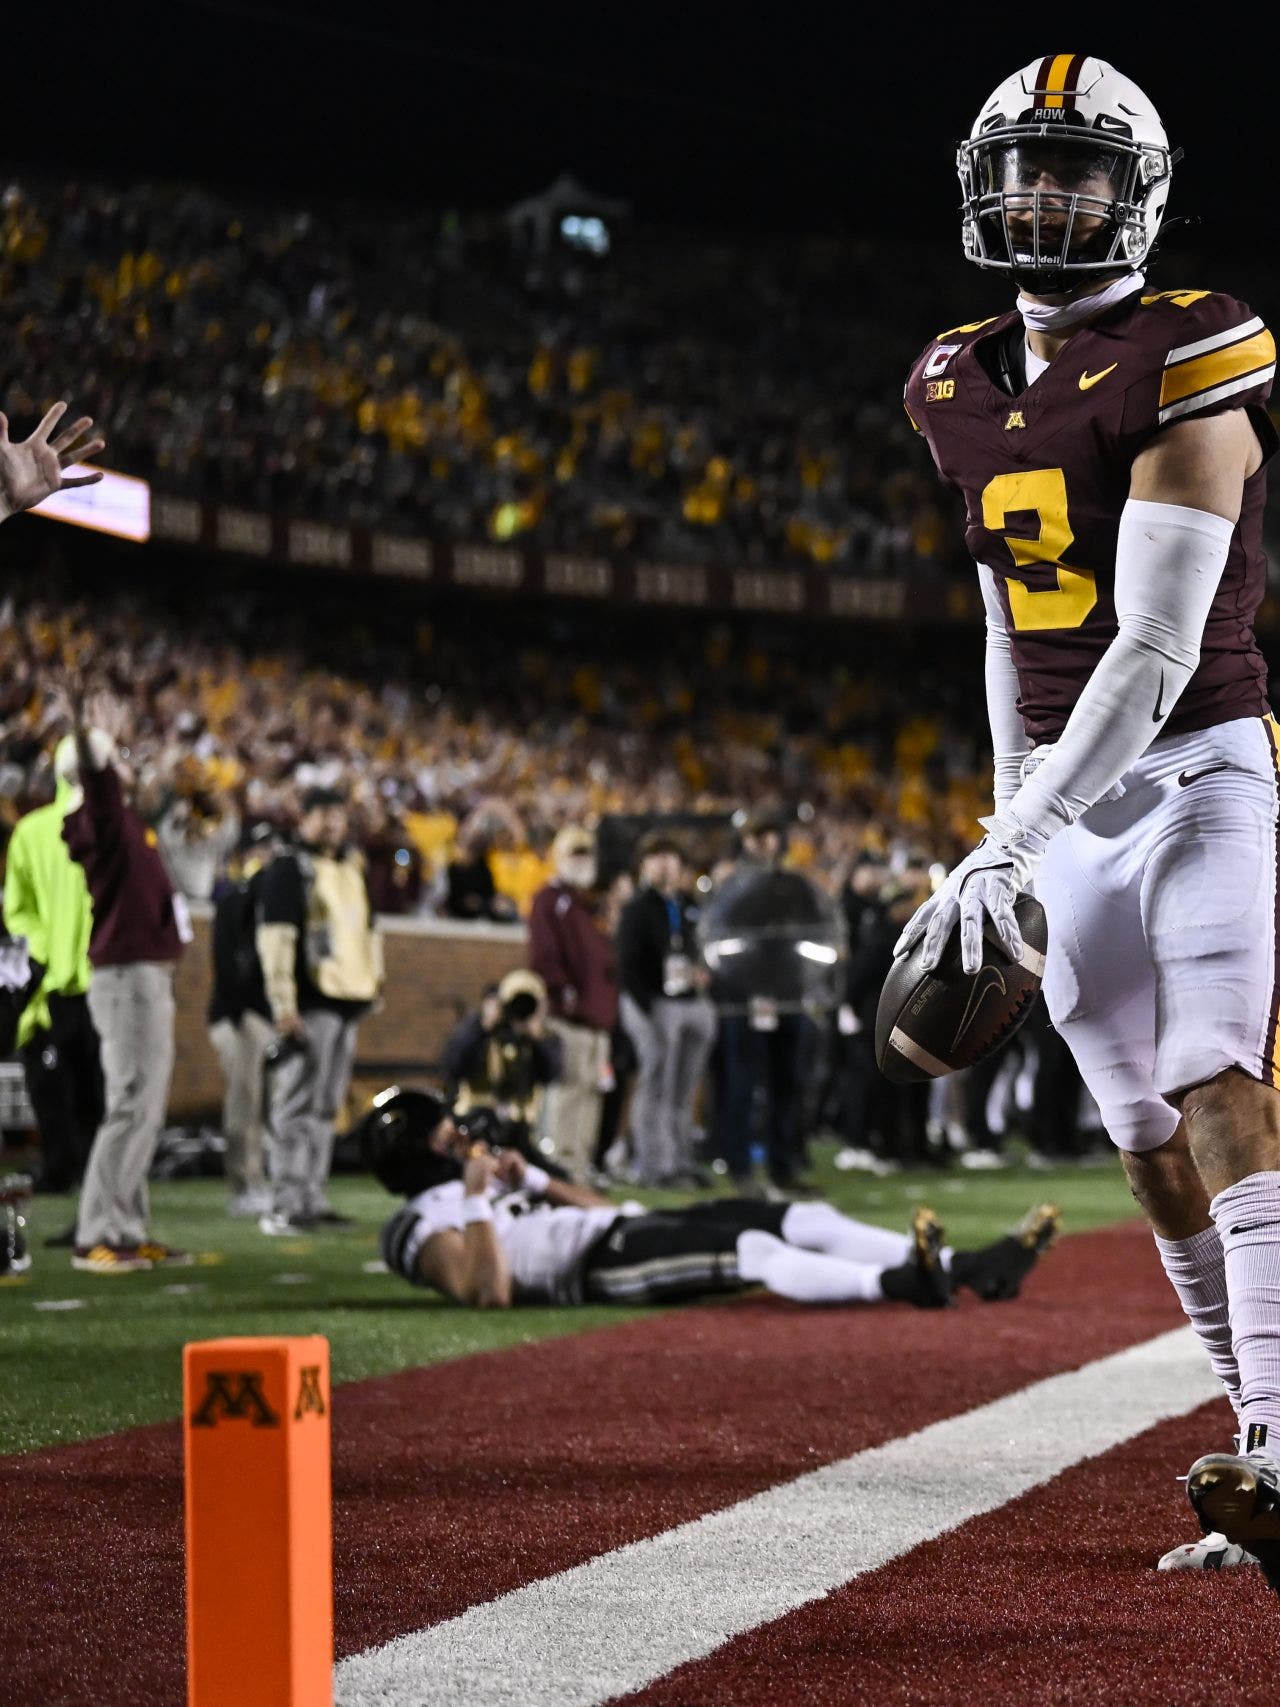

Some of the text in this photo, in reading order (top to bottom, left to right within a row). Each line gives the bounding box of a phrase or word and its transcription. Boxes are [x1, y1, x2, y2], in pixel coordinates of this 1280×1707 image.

[1034, 108, 1066, 121] ROW
[981, 467, 1098, 631] 3
[192, 1370, 279, 1428] M
